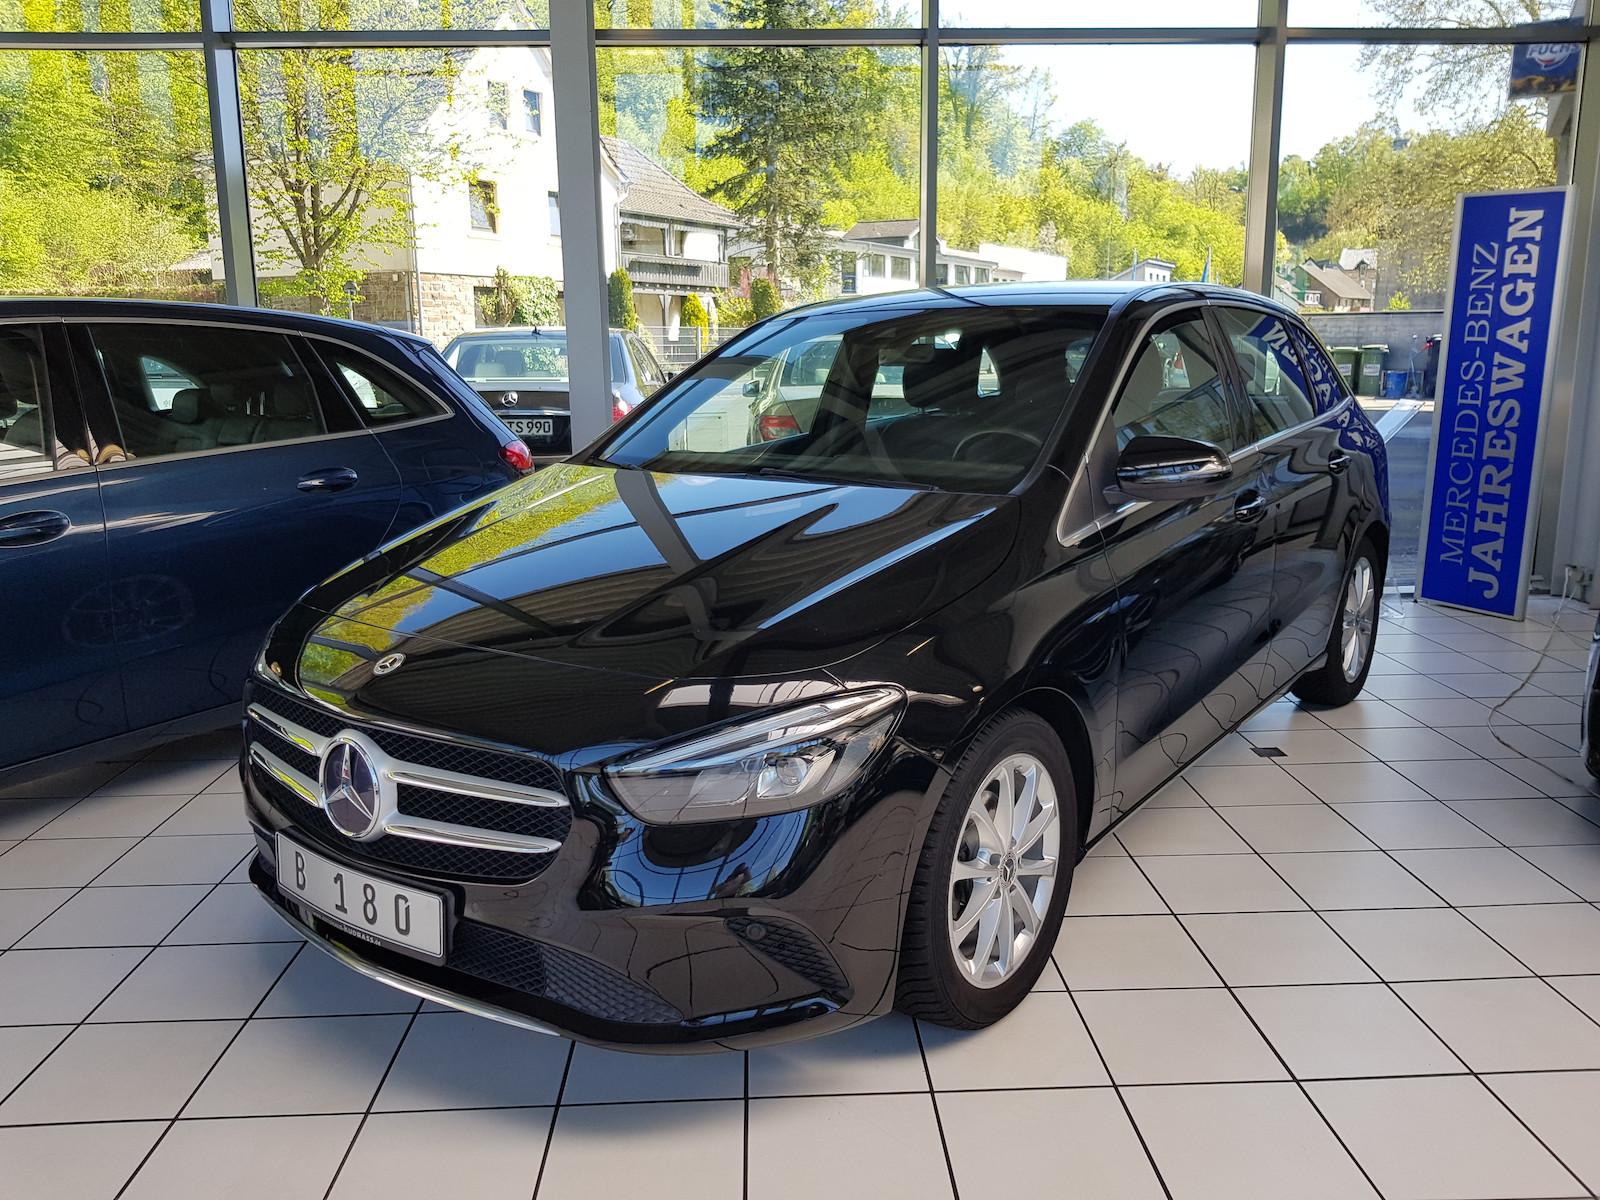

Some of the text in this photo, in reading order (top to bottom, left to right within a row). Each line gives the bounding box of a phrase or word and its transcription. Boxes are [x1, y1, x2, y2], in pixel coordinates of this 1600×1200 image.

[526, 421, 550, 433] 990
[1440, 241, 1499, 566] MERCEDES-BENZ
[1468, 207, 1545, 599] JAHRESWAGEN
[295, 851, 411, 936] B 180
